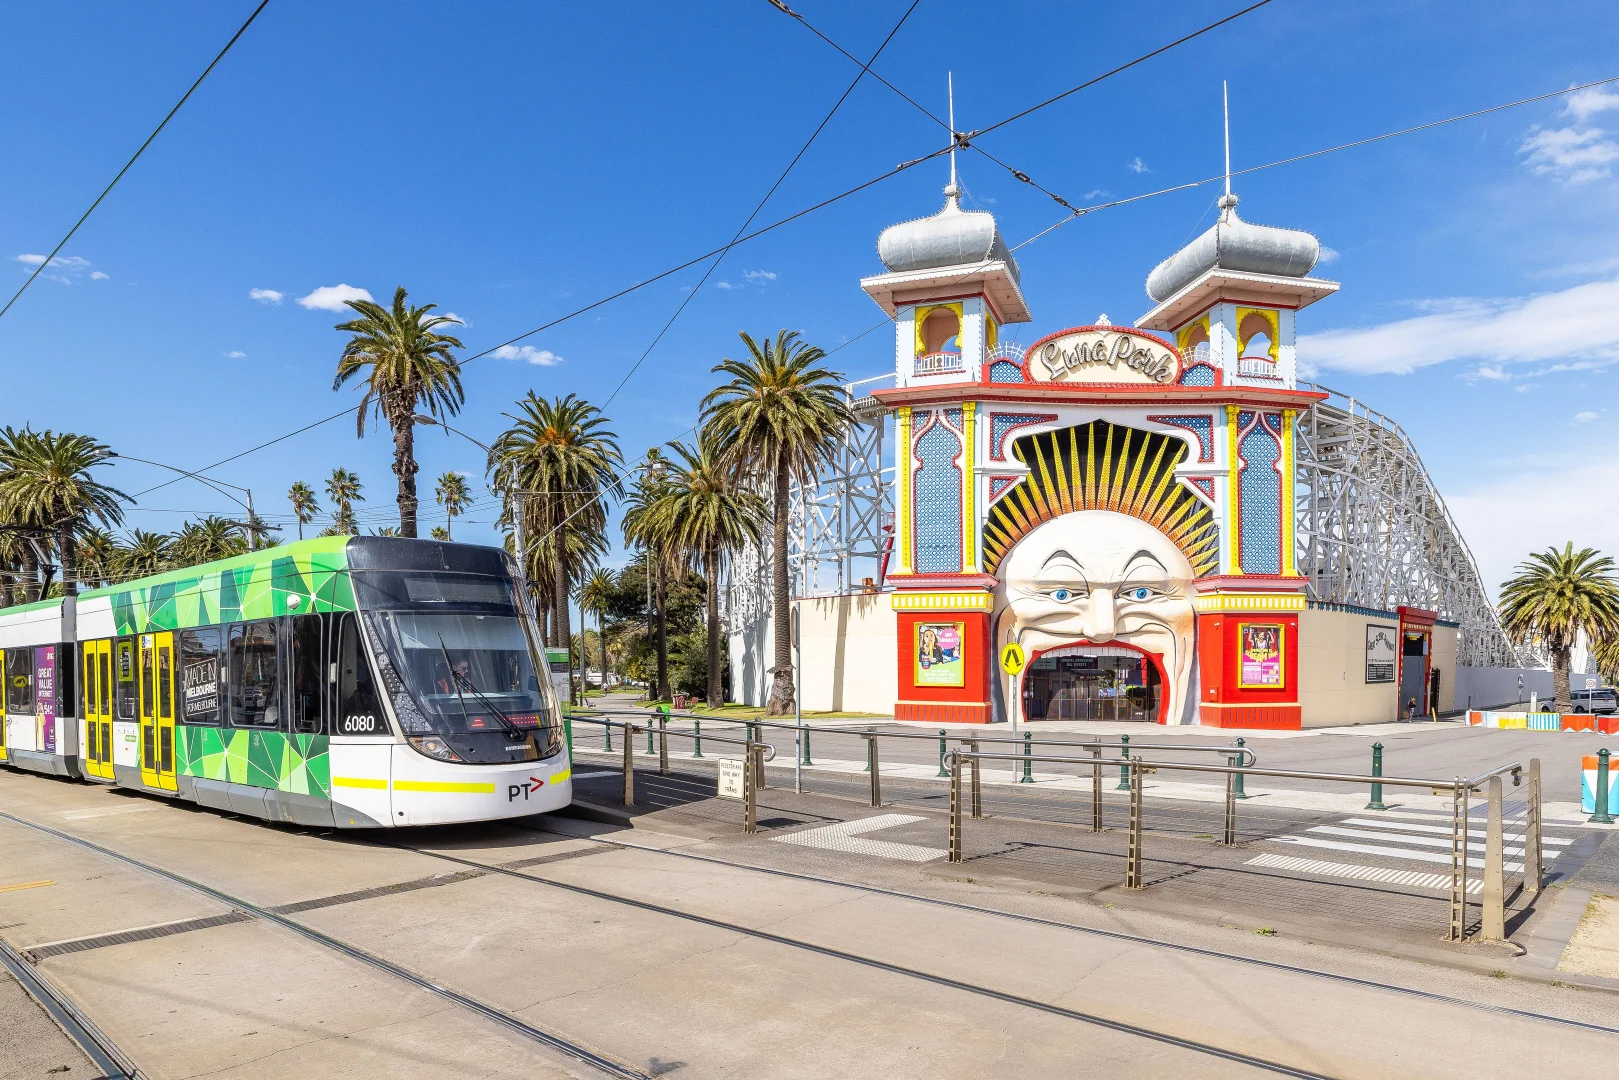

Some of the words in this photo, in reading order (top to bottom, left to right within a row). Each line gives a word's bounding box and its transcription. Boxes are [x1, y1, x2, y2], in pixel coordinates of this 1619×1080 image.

[1040, 339, 1106, 381] Luna
[1107, 334, 1172, 382] Park
[38, 668, 52, 678] GREAT
[38, 679, 52, 689] VALUE
[186, 681, 216, 699] MELBOURNE
[345, 715, 375, 731] 6080
